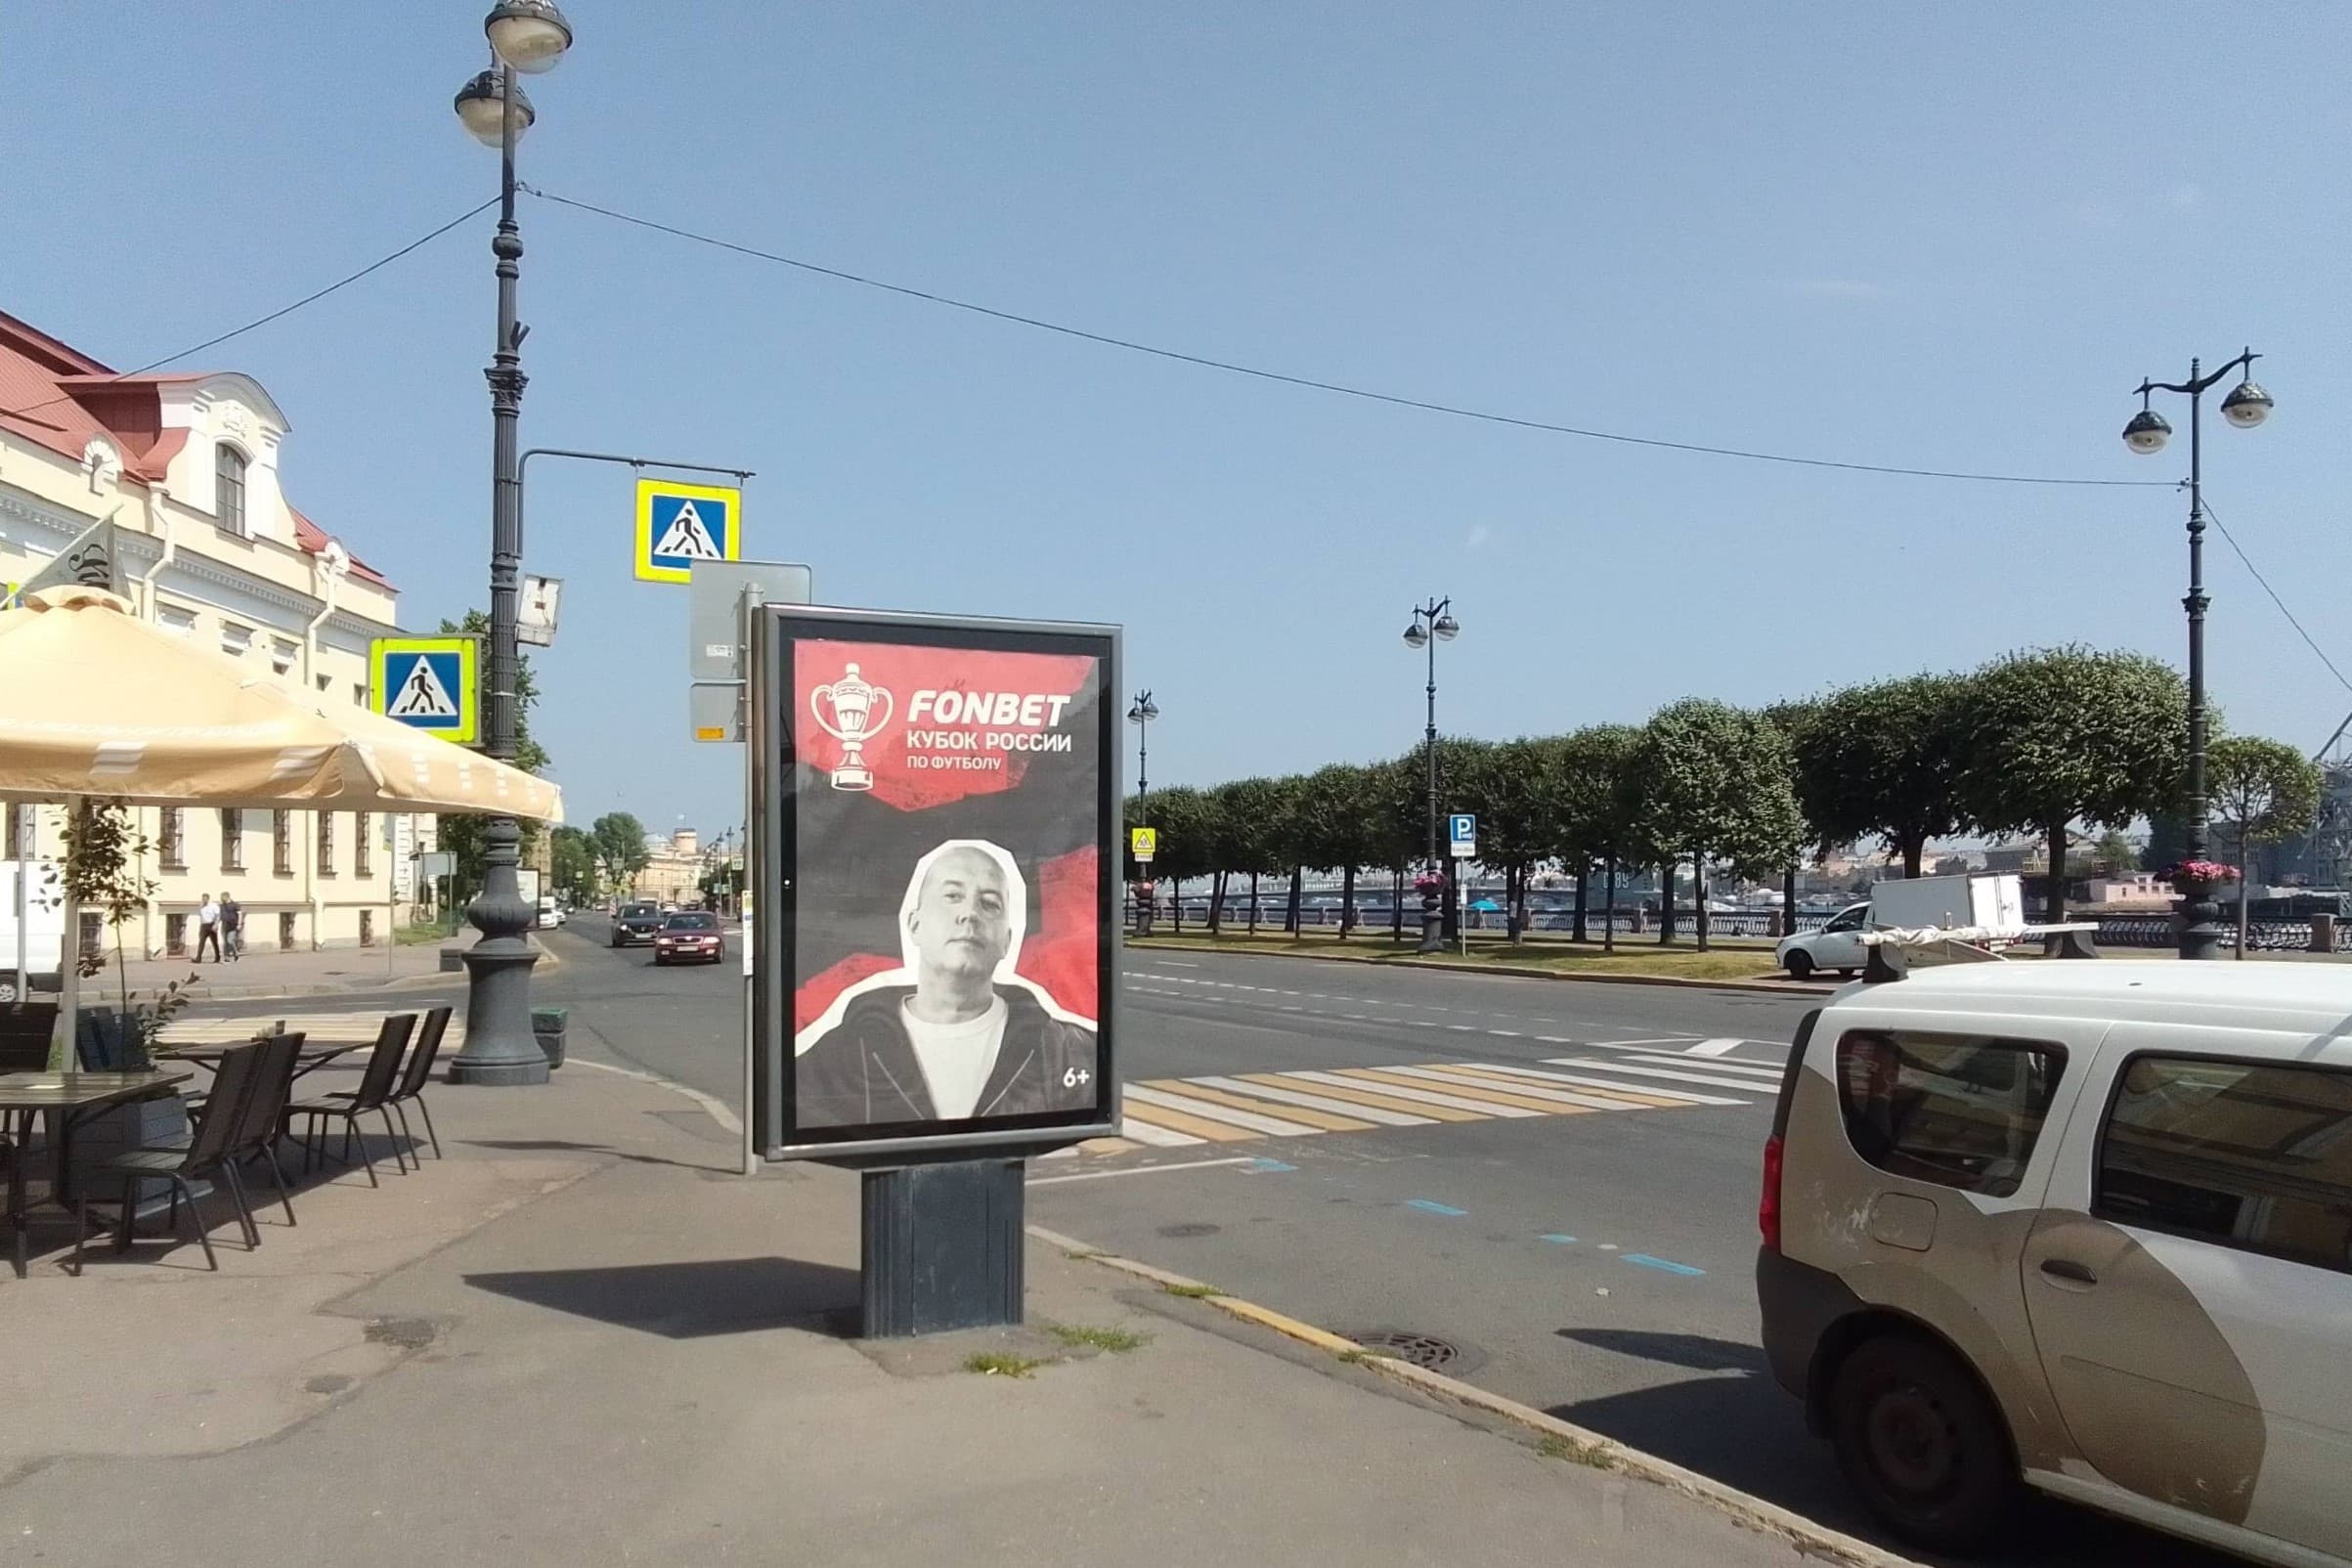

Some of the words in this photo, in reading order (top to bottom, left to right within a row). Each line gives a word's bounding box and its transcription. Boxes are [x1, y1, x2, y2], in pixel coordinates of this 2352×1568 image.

[907, 690, 1071, 726] FONBET
[907, 730, 979, 750] КУБОК
[985, 733, 1072, 752] РОССИИ
[907, 756, 929, 769] ПО
[931, 757, 1002, 770] ФУТБОЛУ
[1457, 818, 1471, 840] P
[1063, 1067, 1090, 1088] 6+
